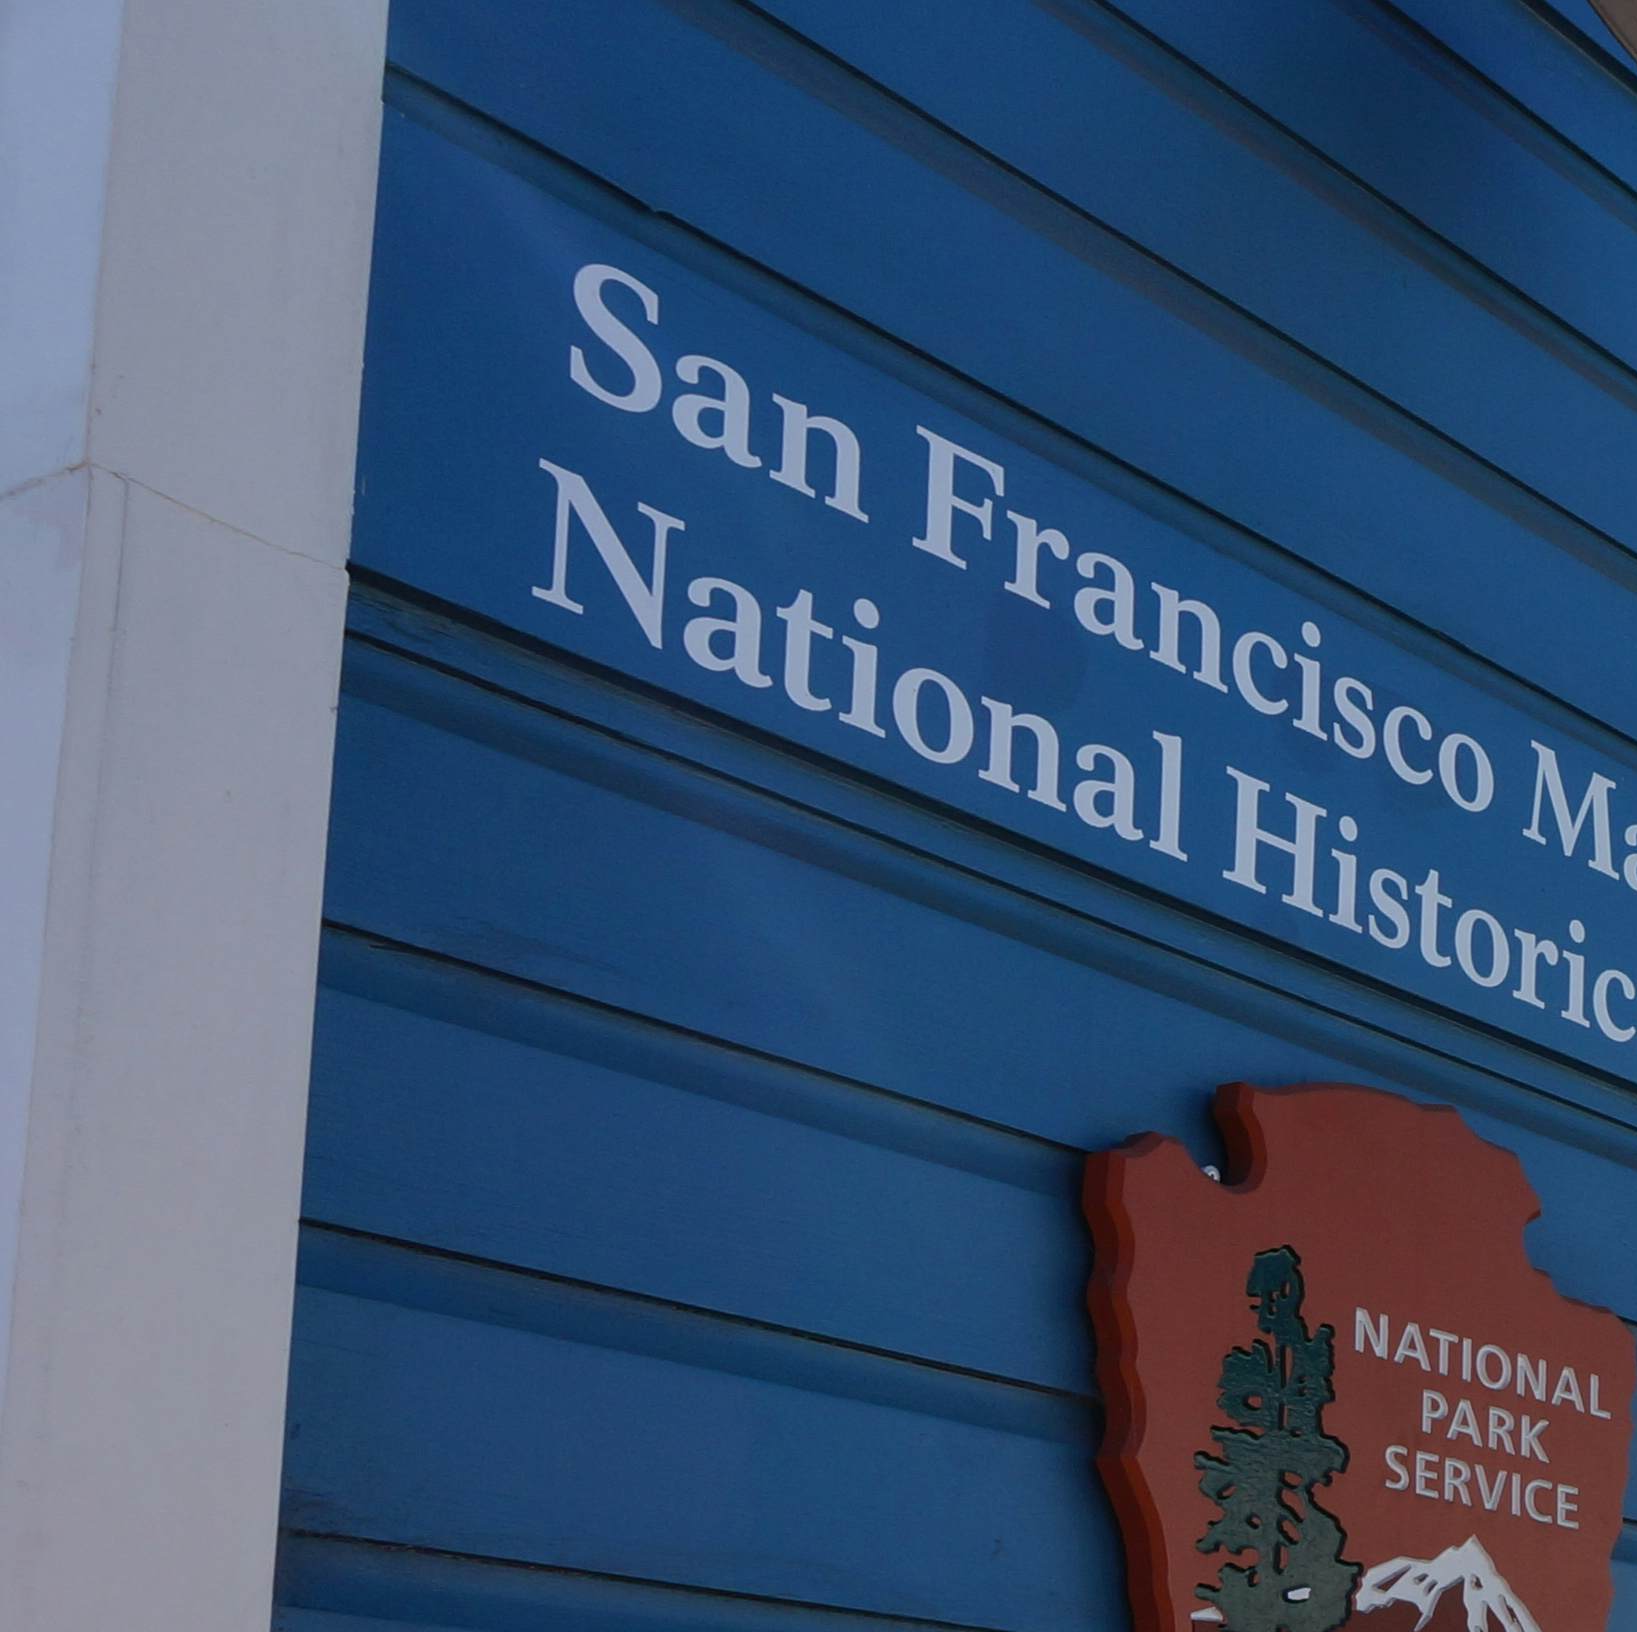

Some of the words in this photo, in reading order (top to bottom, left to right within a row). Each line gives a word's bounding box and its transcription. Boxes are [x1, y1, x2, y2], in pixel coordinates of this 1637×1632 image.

[570, 264, 869, 523] San
[912, 425, 1494, 812] Francisco
[532, 458, 1188, 862] National
[1354, 1306, 1612, 1421] NATIONAL
[1421, 1387, 1550, 1465] PARK
[1384, 1443, 1580, 1530] SERVICE
